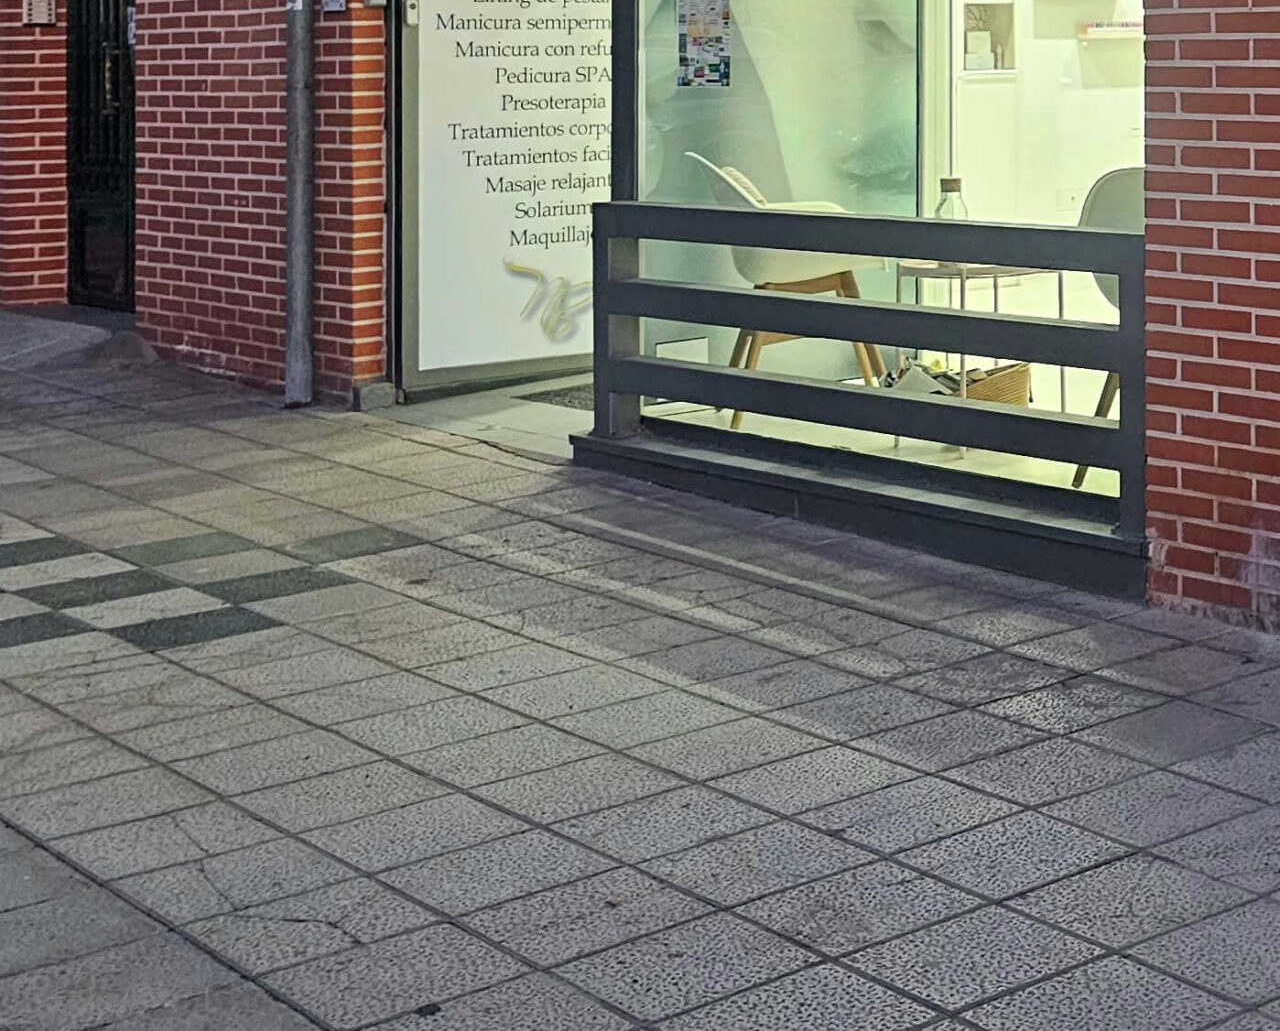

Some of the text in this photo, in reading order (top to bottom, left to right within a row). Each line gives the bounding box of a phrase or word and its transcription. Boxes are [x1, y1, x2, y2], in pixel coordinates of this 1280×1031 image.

[436, 13, 612, 36] Manicura semiperm
[455, 38, 612, 58] Manicura con refu
[495, 65, 612, 85] Pedicura SPA
[501, 93, 606, 116] Presoterapia
[447, 122, 564, 141] Tratamientos
[462, 144, 612, 168] Tratamientos faci
[485, 172, 612, 197] Masaje relajant
[515, 201, 593, 220] Solarium
[509, 225, 594, 251] Maquillaj
